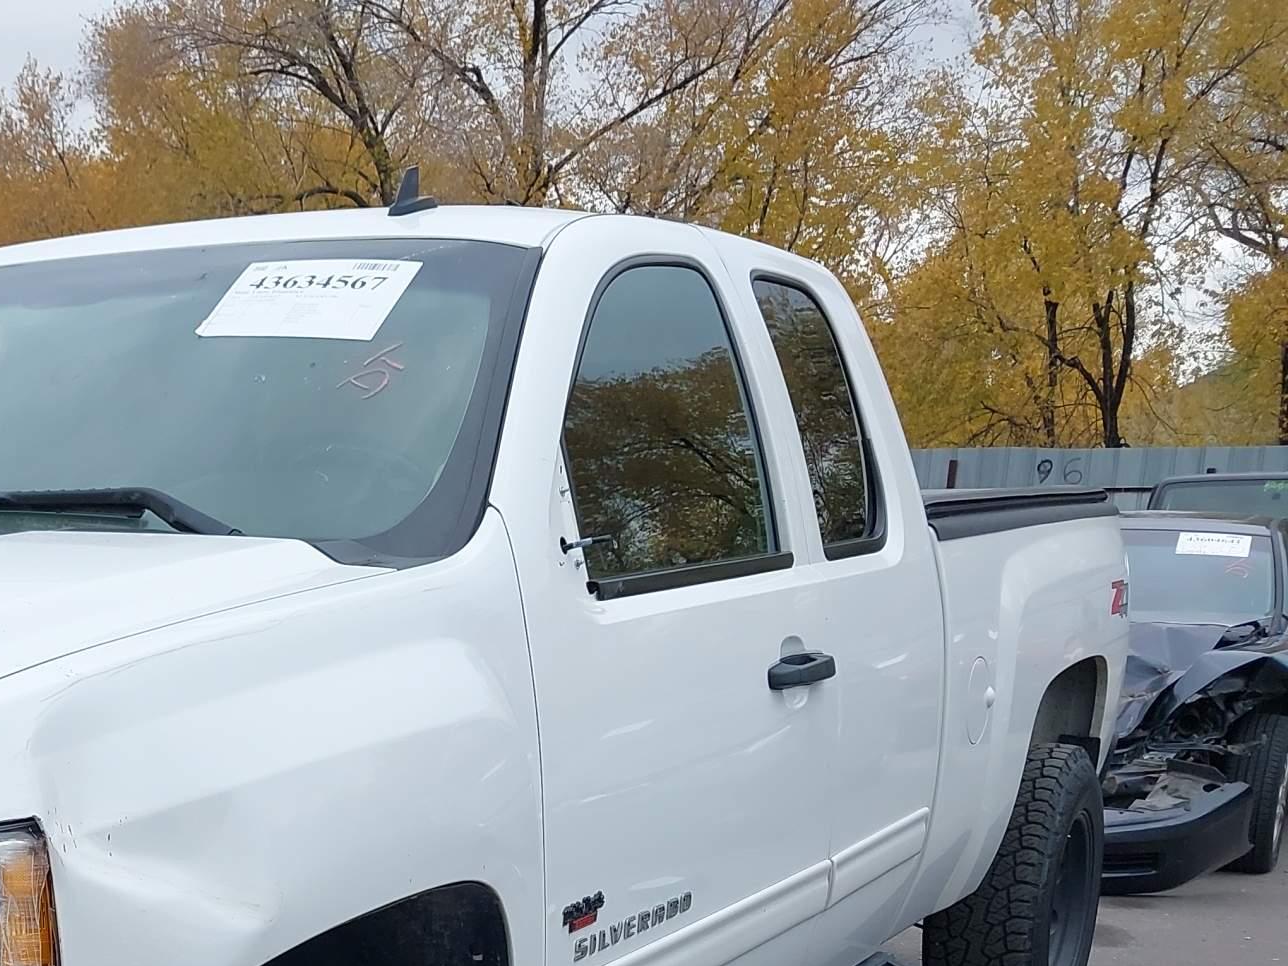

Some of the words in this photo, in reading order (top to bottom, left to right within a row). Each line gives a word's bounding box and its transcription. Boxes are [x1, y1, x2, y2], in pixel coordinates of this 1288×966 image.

[249, 273, 389, 291] 43634567
[1036, 456, 1083, 485] 96
[573, 891, 693, 962] SILVERADO
